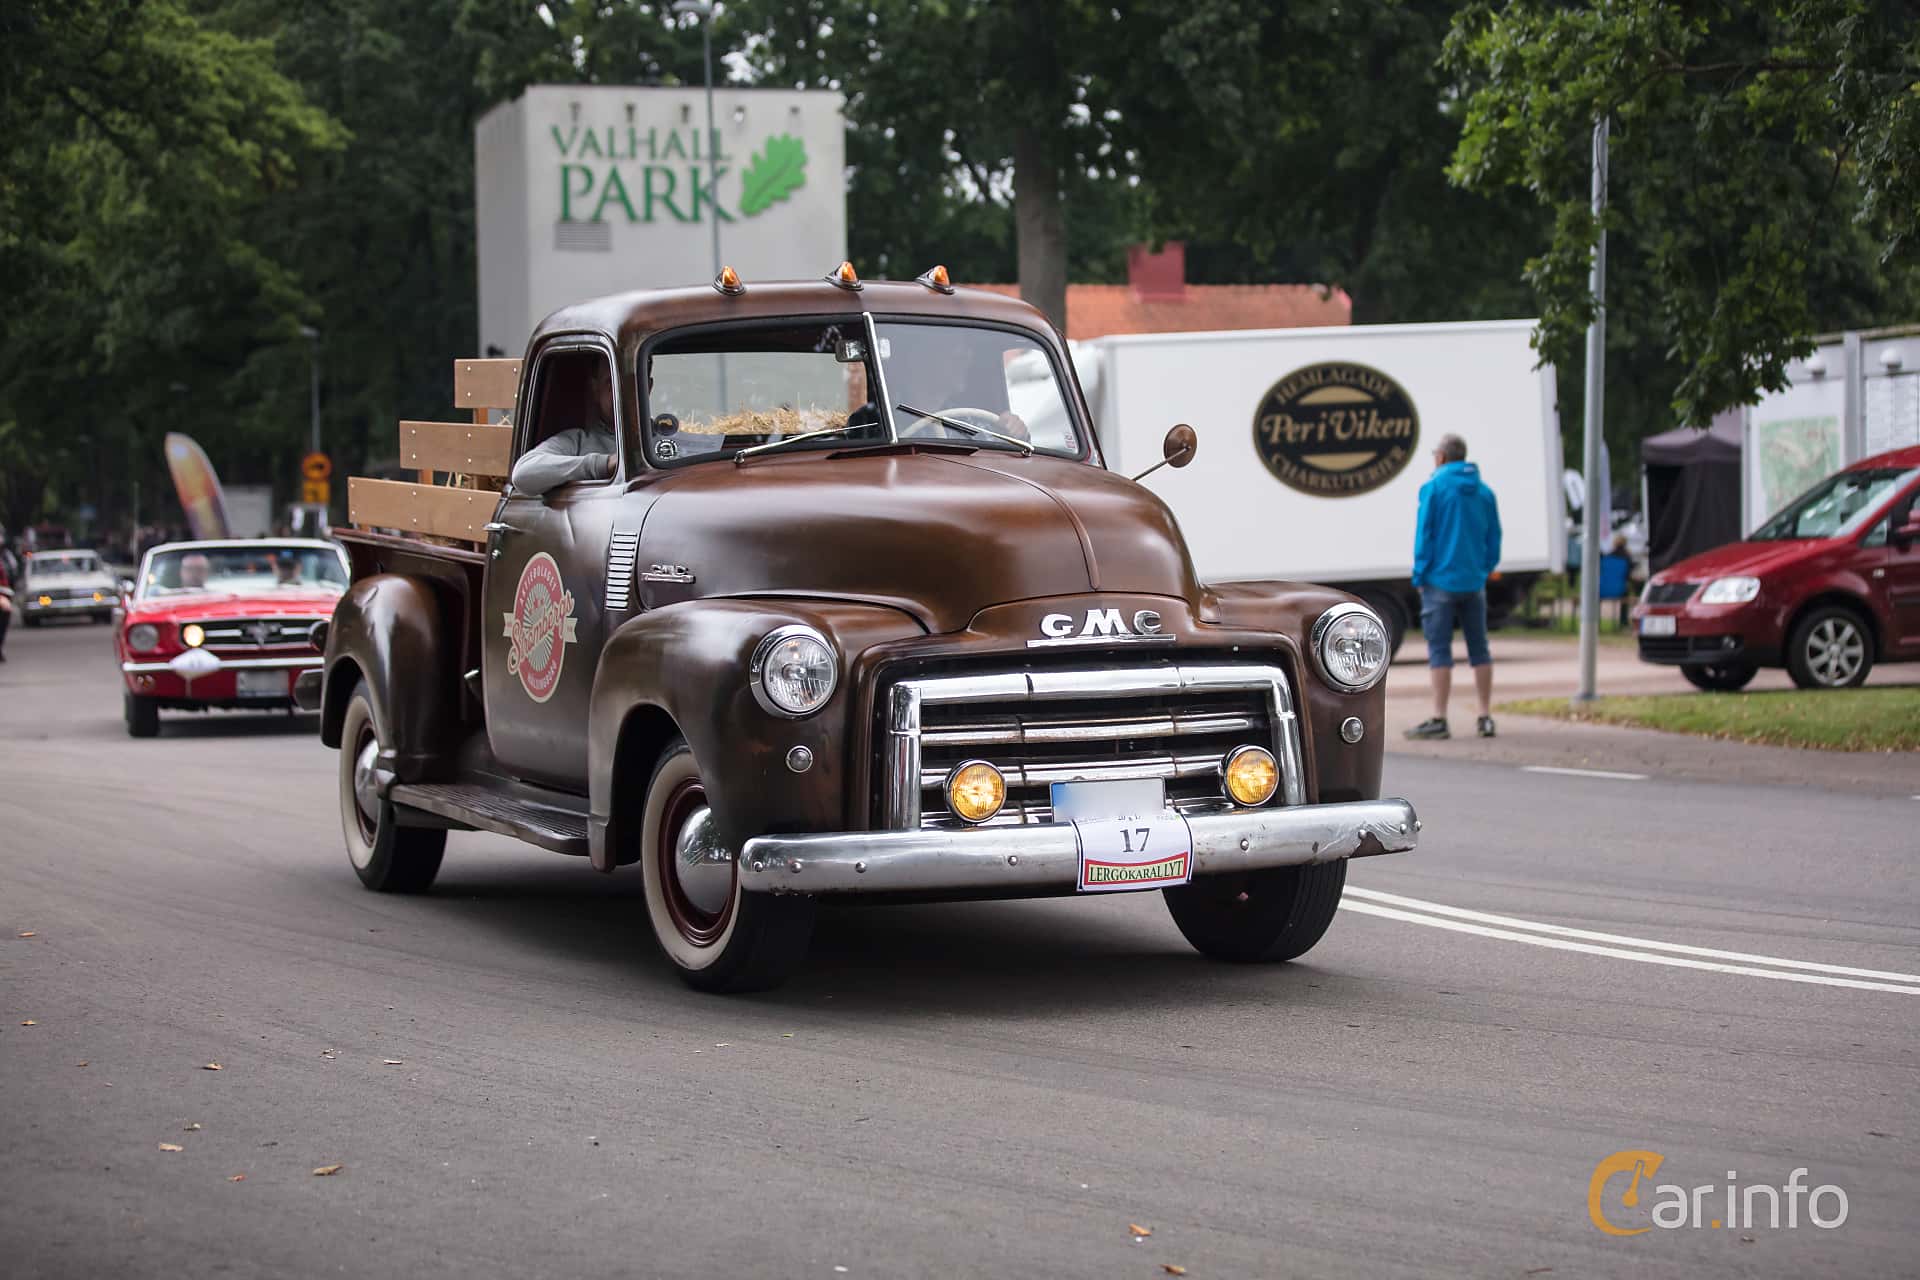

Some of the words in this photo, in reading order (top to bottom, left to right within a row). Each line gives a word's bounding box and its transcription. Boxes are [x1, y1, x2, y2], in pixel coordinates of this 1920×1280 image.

[551, 125, 732, 161] VALHALL
[558, 164, 737, 223] PARK
[1329, 408, 1412, 441] Viken
[1041, 608, 1162, 638] GMC
[1119, 827, 1151, 853] 17
